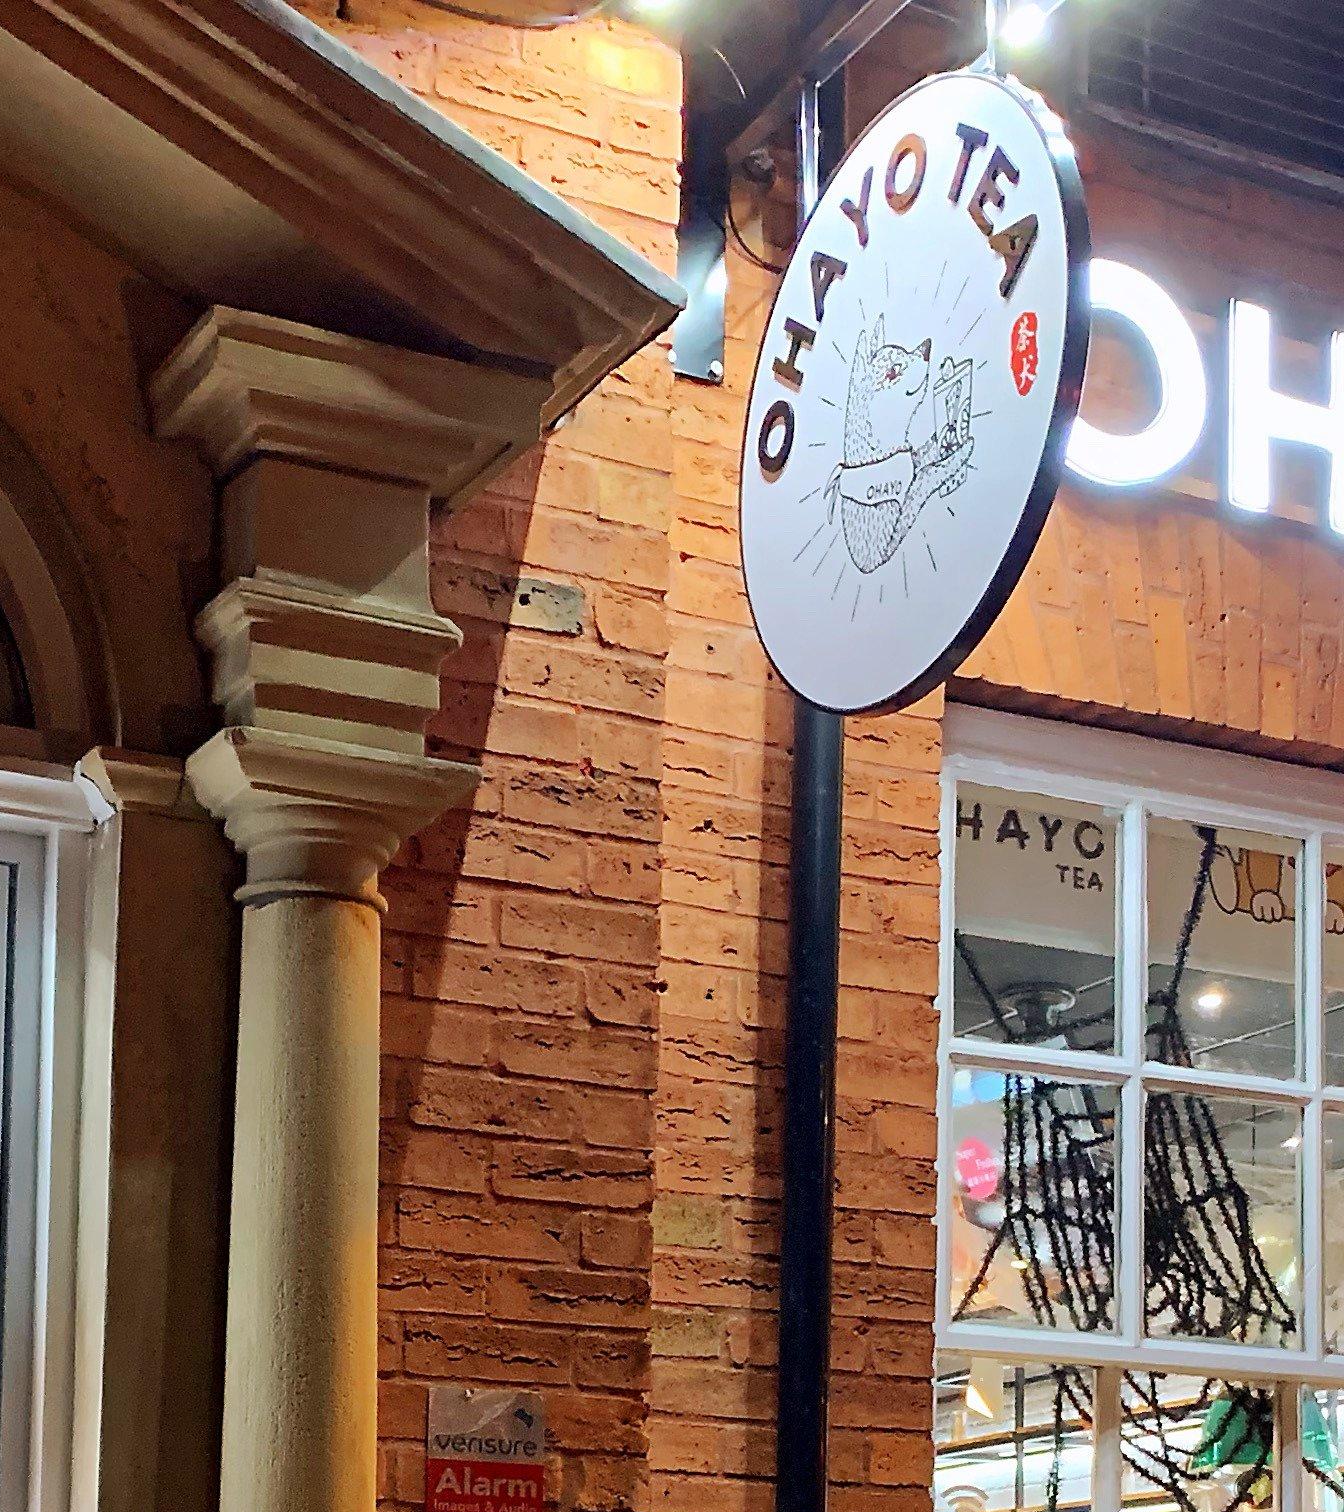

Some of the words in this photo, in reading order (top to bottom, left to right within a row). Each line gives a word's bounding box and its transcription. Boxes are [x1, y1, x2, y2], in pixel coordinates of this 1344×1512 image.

[758, 130, 929, 484] OHAYO
[949, 122, 1040, 302] TEA
[866, 480, 903, 500] OHAYO
[1057, 863, 1104, 893] TEA
[435, 1466, 538, 1499] Alarm
[484, 1501, 494, 1512] &
